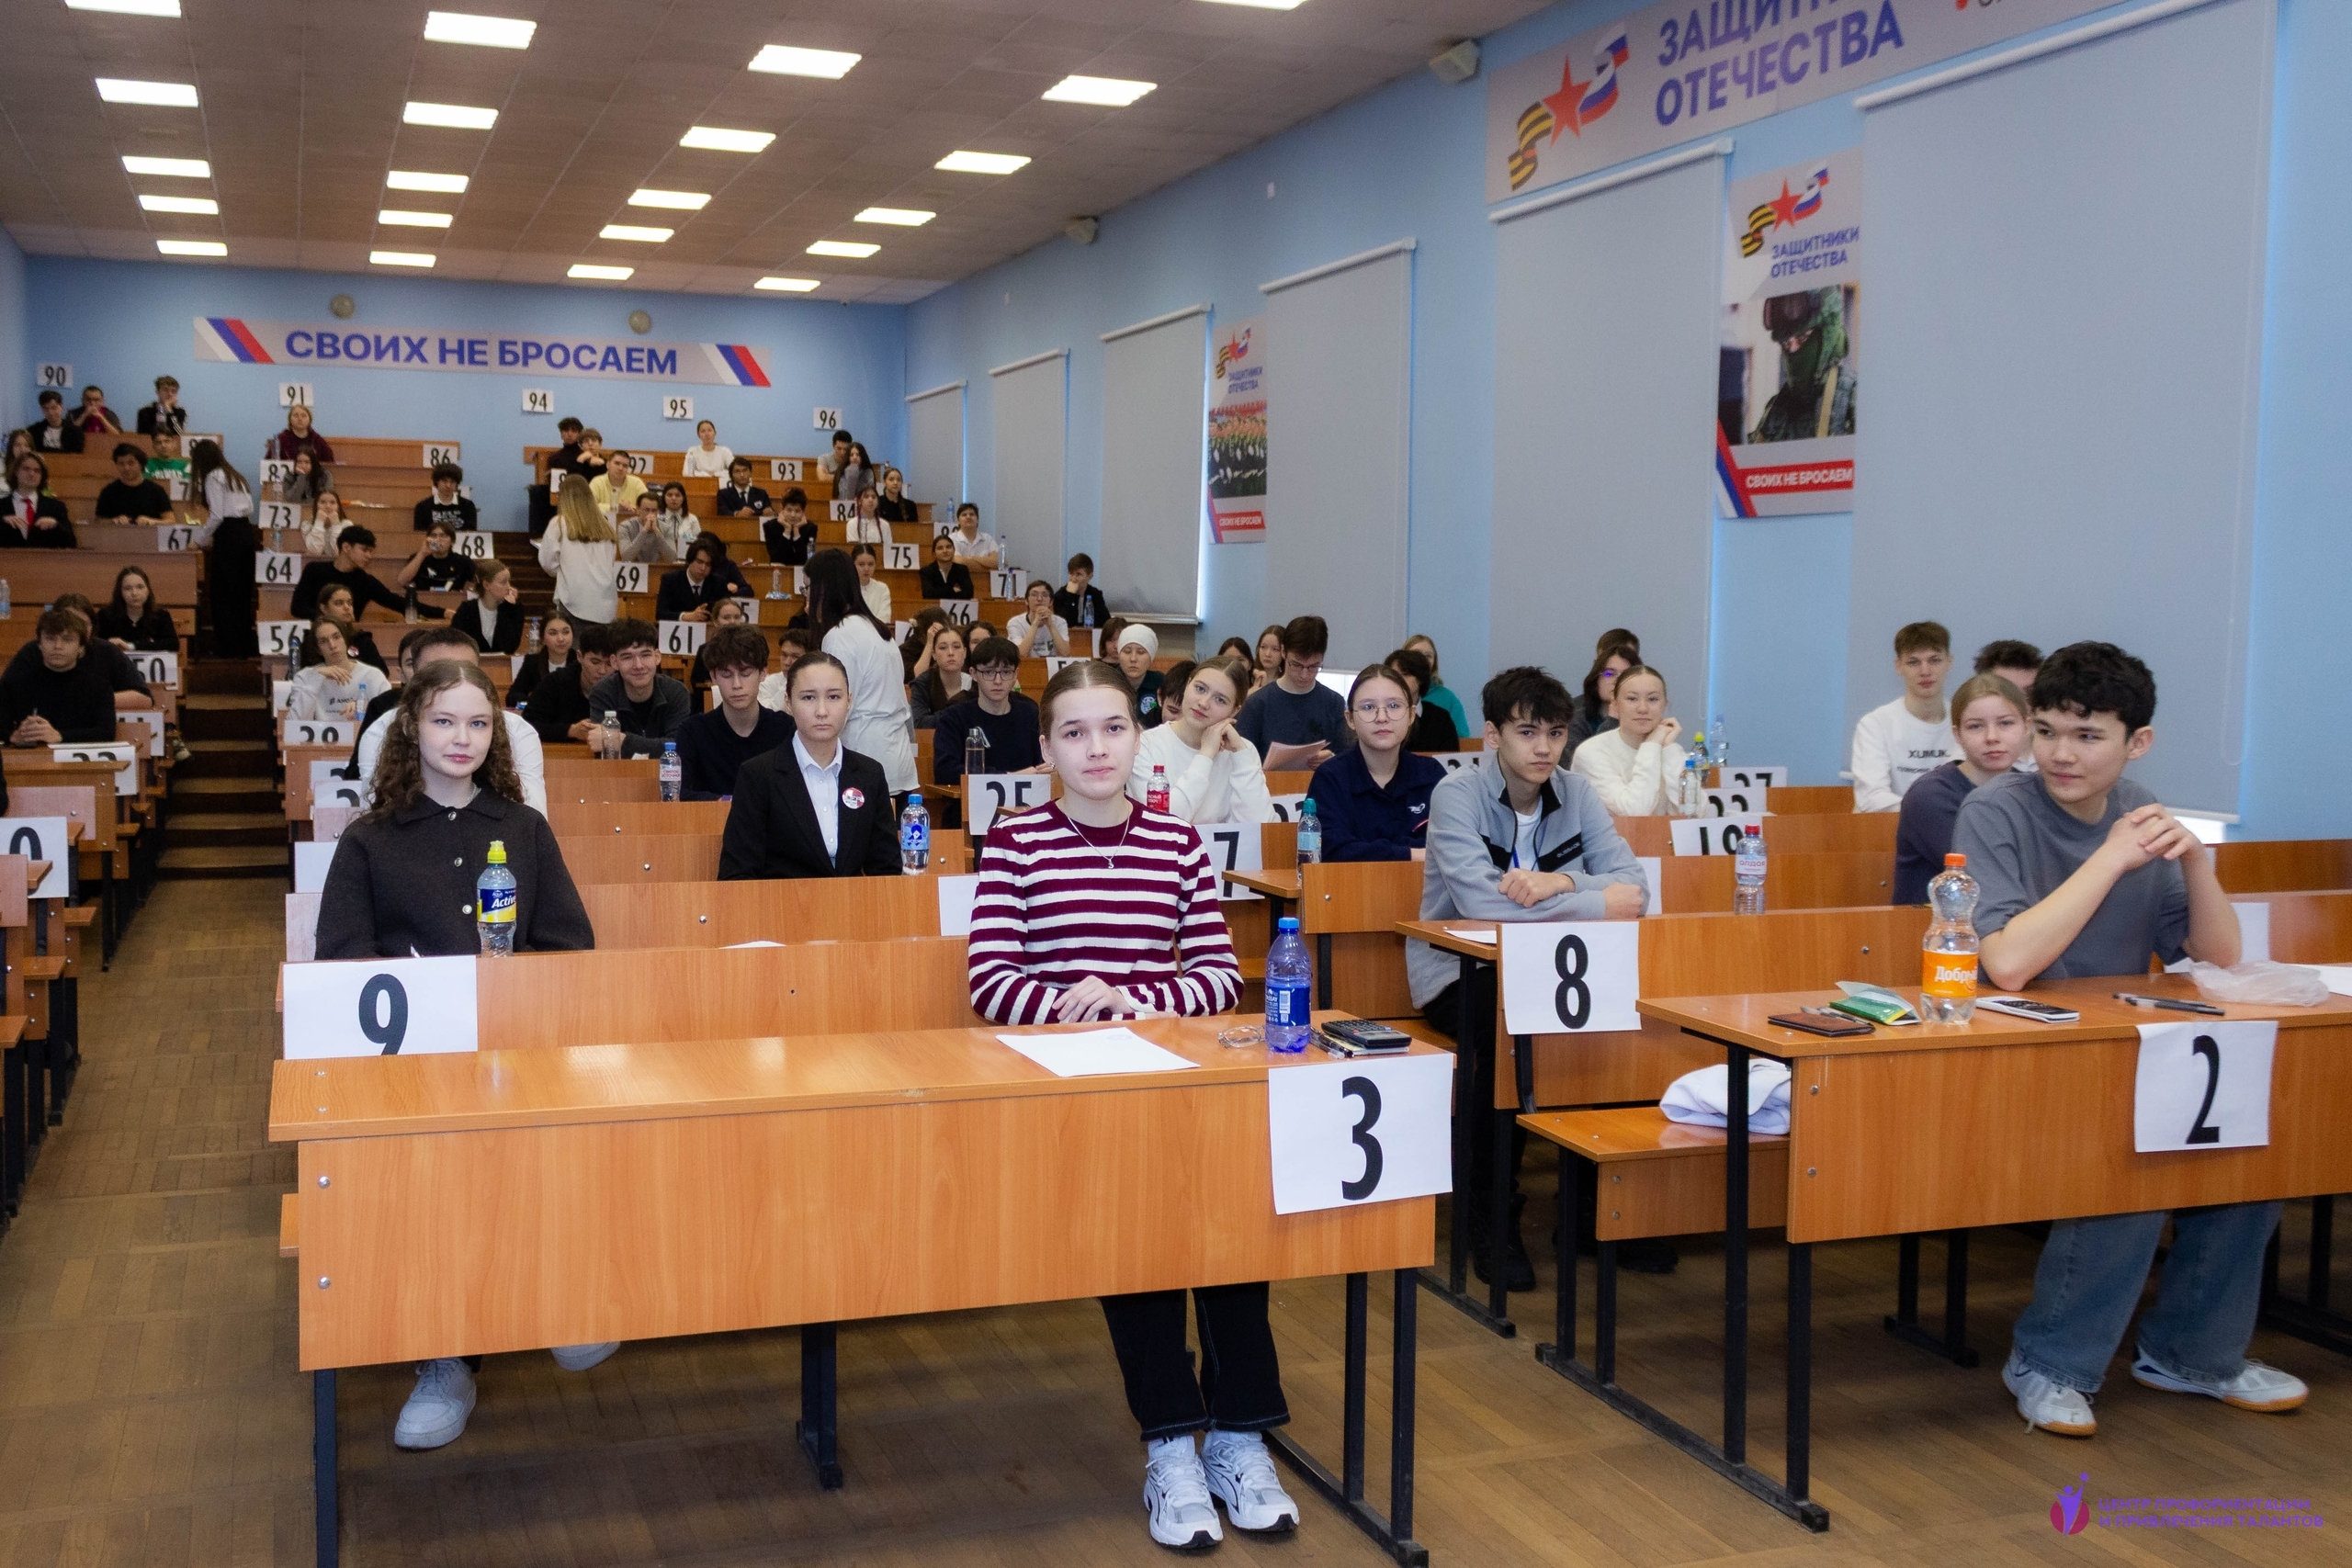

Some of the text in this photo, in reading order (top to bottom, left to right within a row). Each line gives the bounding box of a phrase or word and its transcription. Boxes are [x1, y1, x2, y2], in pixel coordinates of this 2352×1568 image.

[1656, 0, 1905, 126] ОТЕЧЕСТВА
[1771, 226, 1860, 259] ЗАЩИТНИКИ
[1770, 249, 1848, 278] ОТЕЧЕСТВА
[285, 331, 677, 375] СВОИХ НЕ БРОСАЕМ
[45, 366, 66, 387] 90
[287, 386, 304, 405] 91
[529, 392, 548, 411] 94
[670, 399, 687, 417] 95
[820, 410, 836, 428] 96
[430, 447, 451, 467] 86
[778, 463, 796, 480] 93
[1747, 468, 1852, 489] СВОИХ НЕ БРОСАЕМ
[268, 505, 291, 528] 73
[837, 502, 856, 521] 84
[167, 528, 192, 550] 67
[461, 536, 485, 558] 68
[266, 557, 291, 582] 64
[890, 547, 912, 569] 75
[616, 566, 640, 591] 69
[949, 603, 970, 626] 66
[669, 626, 693, 653] 61
[986, 781, 1032, 828] 25
[1555, 933, 1591, 1030] 8
[358, 973, 409, 1055] 9
[2185, 1034, 2221, 1145] 2
[1341, 1076, 1384, 1201] 3
